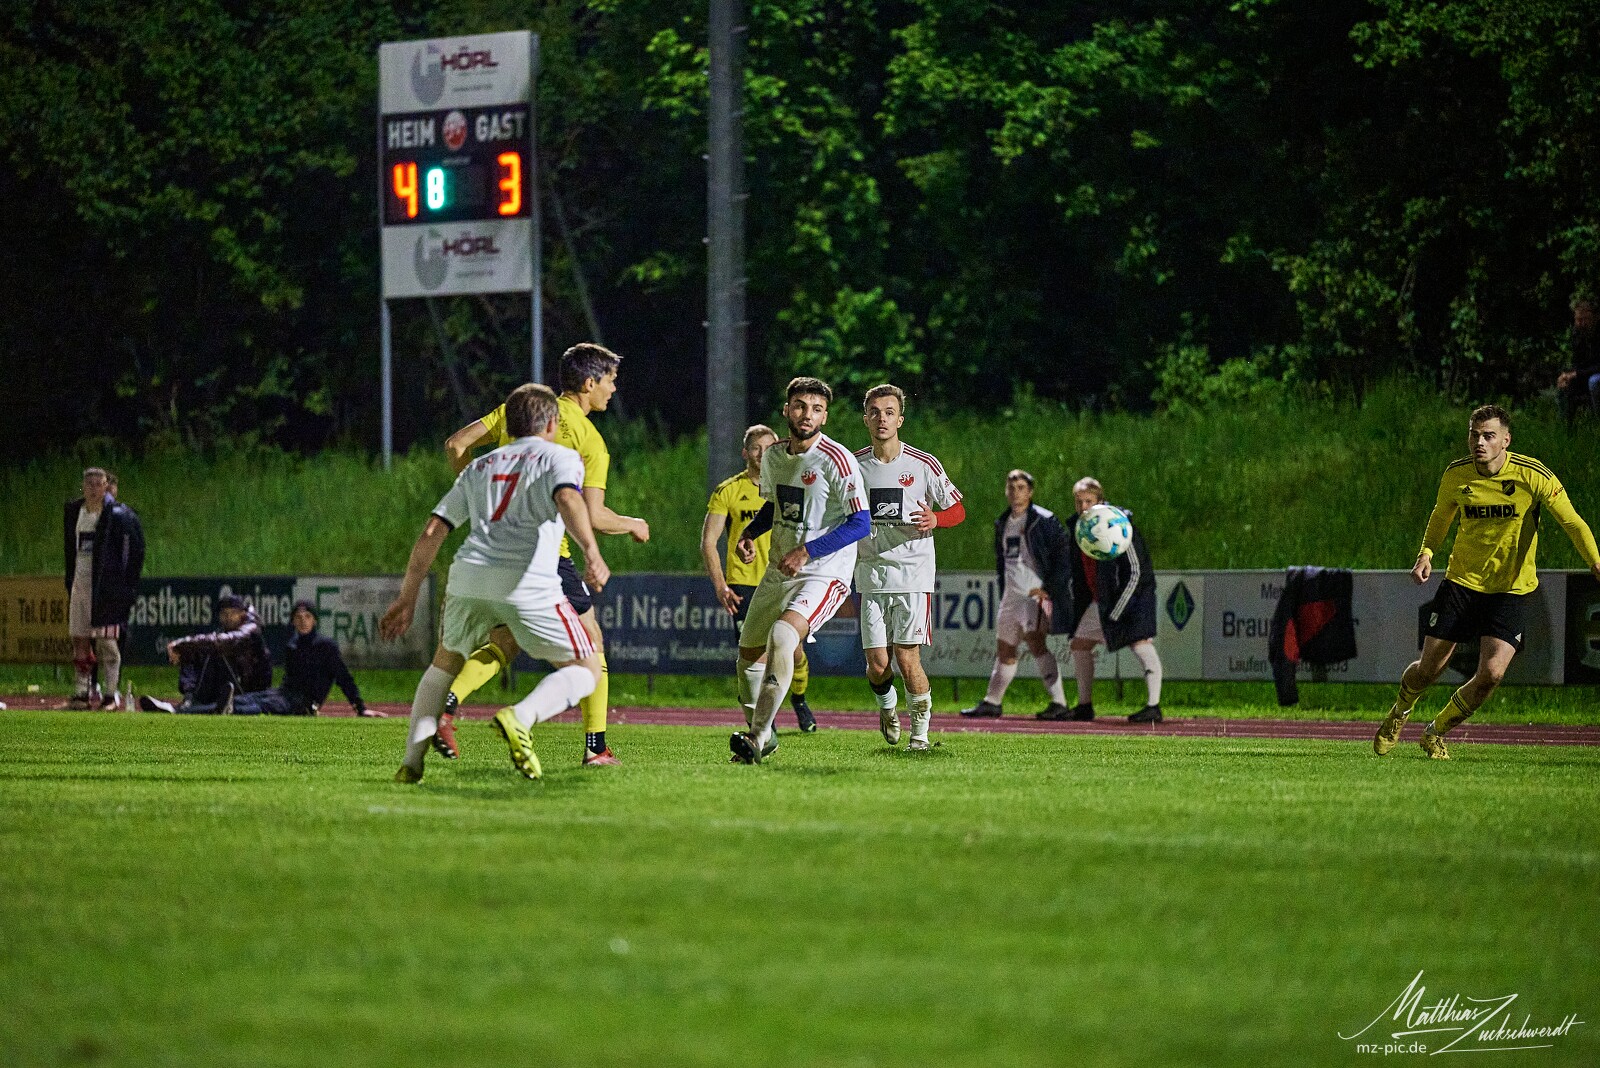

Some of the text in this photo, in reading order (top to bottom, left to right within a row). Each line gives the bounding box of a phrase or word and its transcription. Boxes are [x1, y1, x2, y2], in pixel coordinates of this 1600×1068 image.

[441, 46, 499, 71] HÖRL
[387, 119, 436, 149] HEIM
[475, 111, 526, 142] GAST
[392, 161, 419, 219] 4
[427, 167, 446, 210] 8
[497, 151, 522, 216] 3
[442, 231, 501, 256] HÖRL
[490, 472, 521, 523] 7
[1463, 504, 1521, 519] MEINDL
[1222, 611, 1269, 638] Brau
